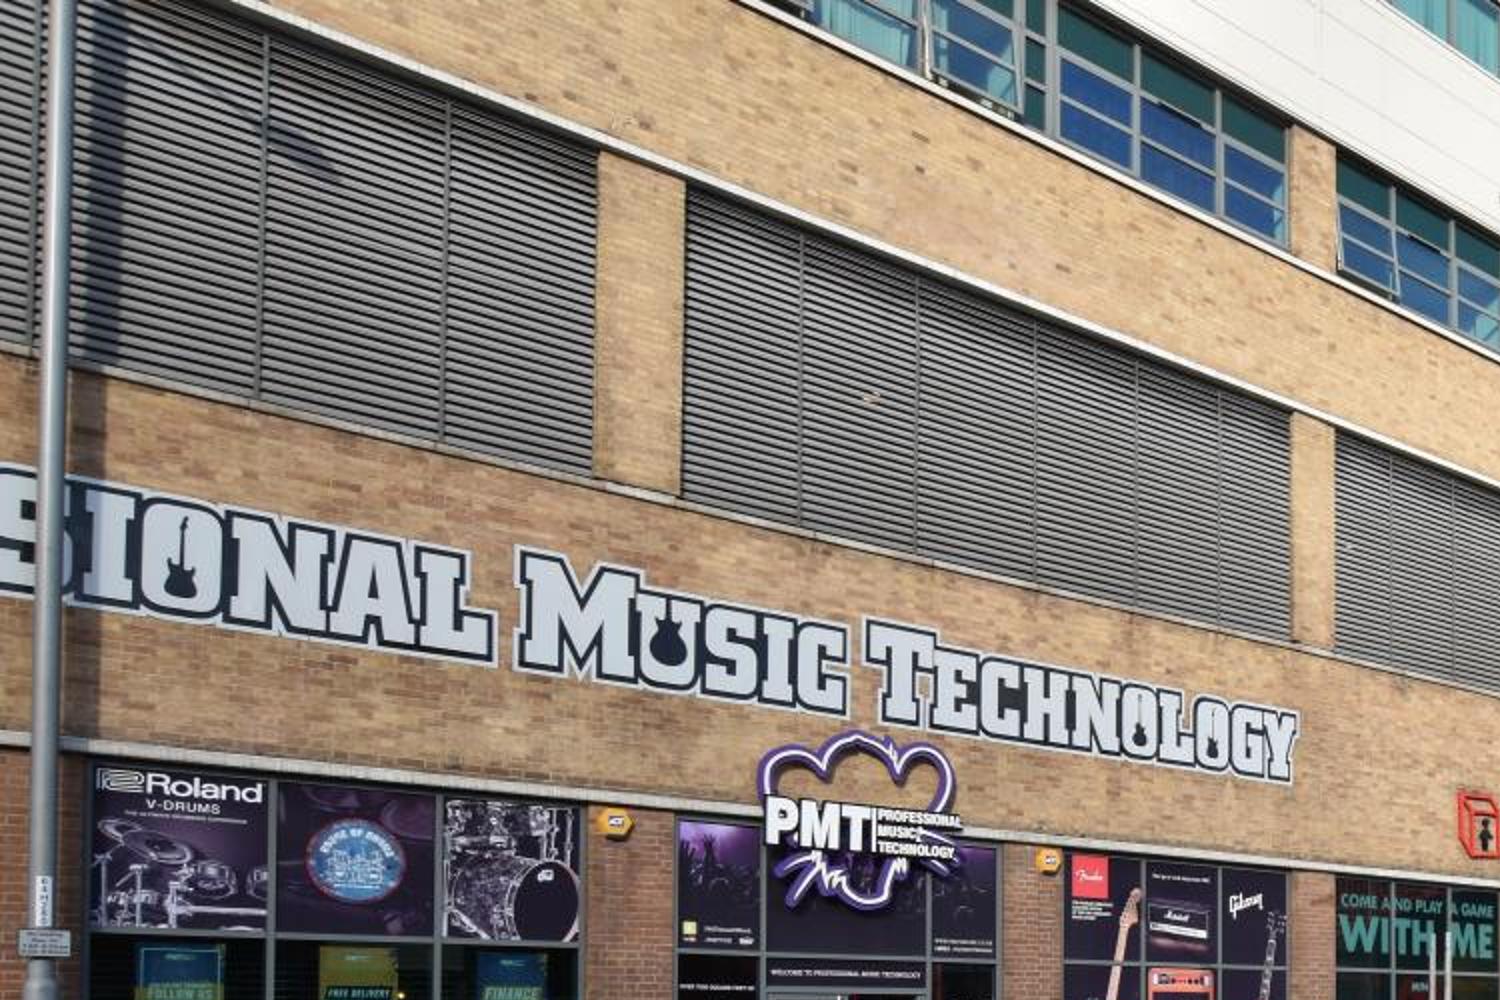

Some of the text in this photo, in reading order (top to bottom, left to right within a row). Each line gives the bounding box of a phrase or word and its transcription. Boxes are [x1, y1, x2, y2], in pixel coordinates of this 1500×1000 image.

[513, 544, 851, 720] MUSIC
[862, 615, 1300, 785] TECHNOLOGY
[146, 773, 263, 803] Roland
[146, 799, 221, 815] V-DRUMS
[877, 808, 961, 829] PROFESSIONAL
[765, 795, 872, 852] PMT
[877, 826, 919, 838] MUSIC
[878, 840, 956, 859] TECHNOLOGY
[1229, 891, 1263, 919] Gibson
[1341, 893, 1495, 919] COME AND PLAY A GAME
[1339, 913, 1495, 959] WITH ME
[484, 987, 542, 1000] FINANCE
